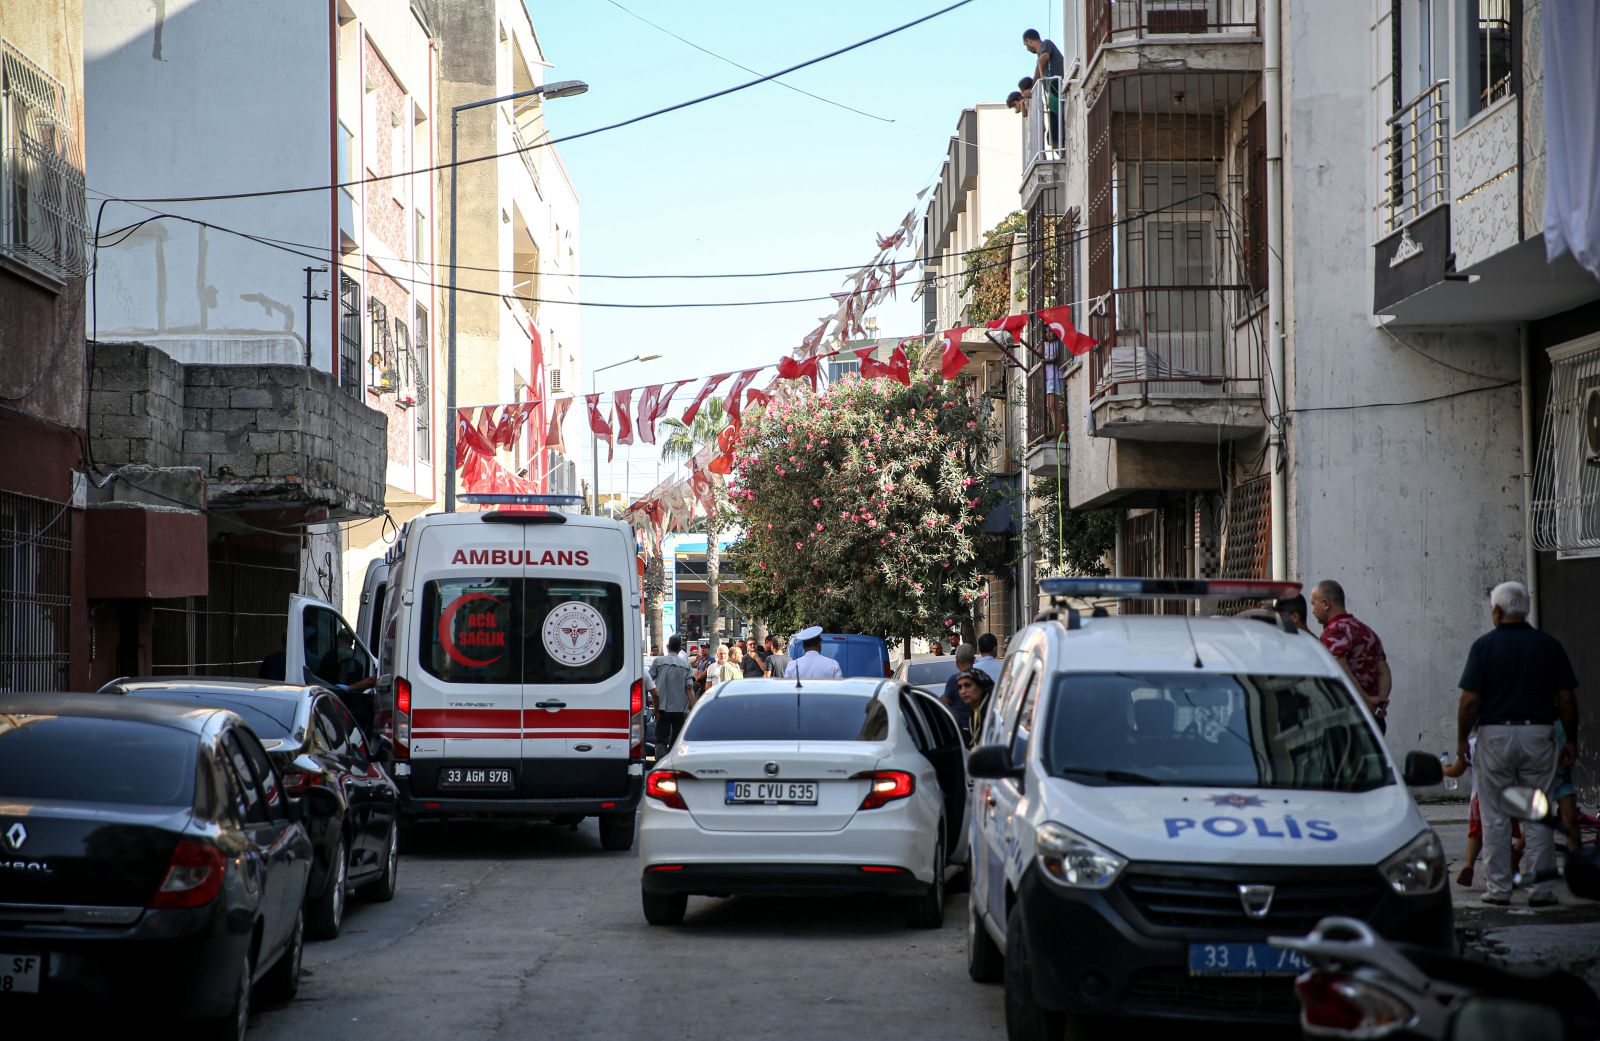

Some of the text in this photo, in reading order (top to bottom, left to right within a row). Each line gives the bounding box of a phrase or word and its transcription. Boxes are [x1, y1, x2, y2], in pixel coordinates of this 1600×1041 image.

[451, 549, 590, 566] AMBULANS
[459, 629, 505, 646] SAĞLIK
[448, 770, 508, 783] 33 AGM 978
[735, 783, 751, 798] 06
[758, 784, 783, 798] CVU
[789, 785, 813, 799] 635
[1163, 814, 1339, 841] POLİS
[1204, 945, 1229, 967] 33
[1246, 945, 1257, 968] A
[13, 957, 36, 974] SF
[0, 975, 14, 990] 8
